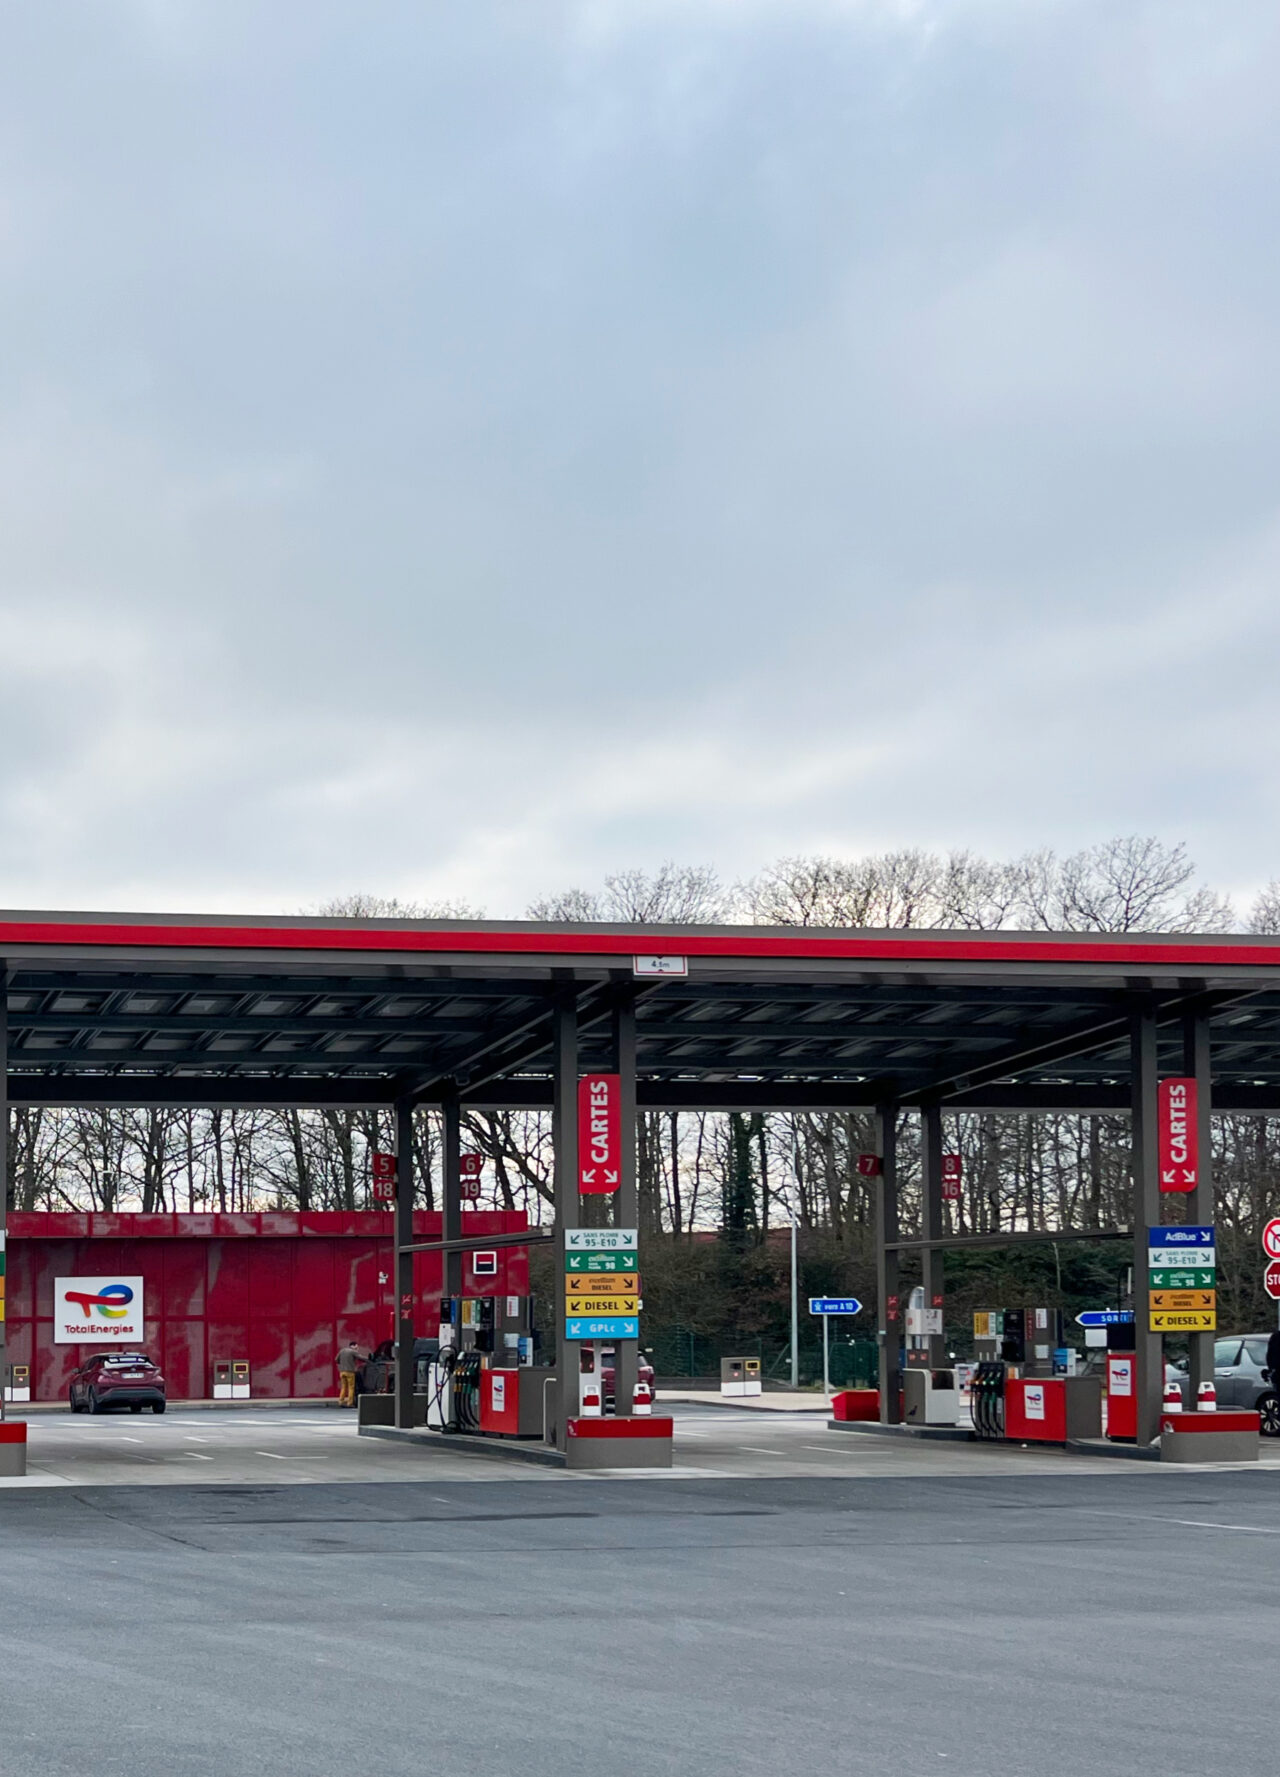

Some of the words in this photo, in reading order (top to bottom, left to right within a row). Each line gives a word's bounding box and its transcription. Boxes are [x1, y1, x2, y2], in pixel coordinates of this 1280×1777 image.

[591, 1081, 609, 1163] CARTES
[1169, 1085, 1187, 1163] CARTES
[379, 1157, 389, 1171] 5
[465, 1157, 476, 1171] 6
[865, 1159, 874, 1172] 7
[945, 1158, 955, 1172] 8
[376, 1183, 393, 1197] 18
[462, 1182, 480, 1197] 19
[942, 1182, 958, 1196] 16
[585, 1239, 617, 1247] 95-E10
[585, 1301, 619, 1310] DIESEL
[589, 1324, 615, 1332] GPLc
[1167, 1317, 1198, 1325] DIESEL
[64, 1324, 134, 1335] TotalEnergies
